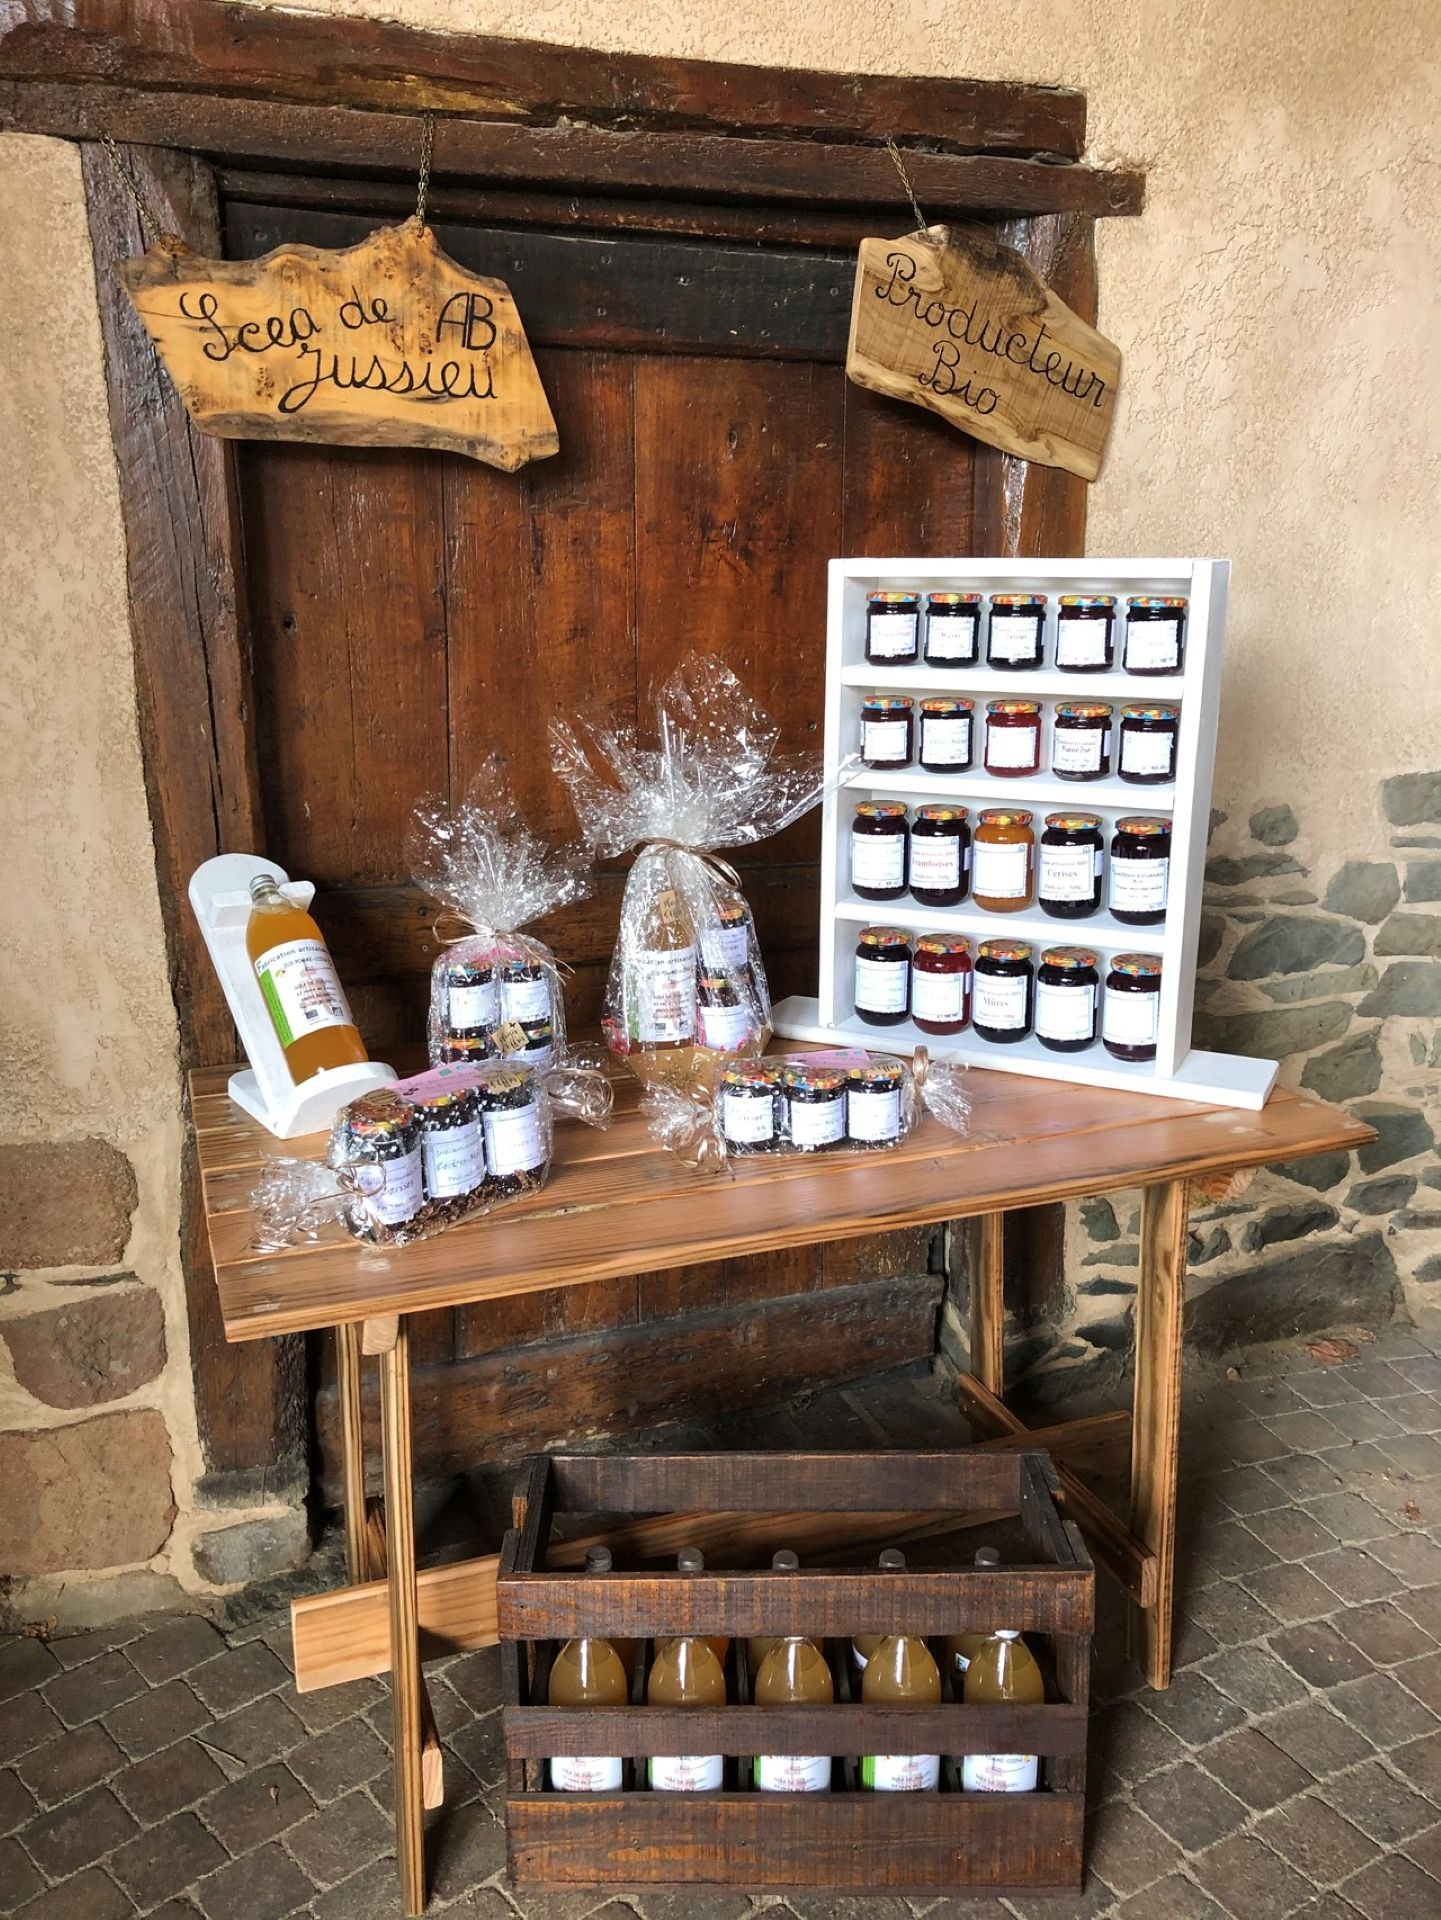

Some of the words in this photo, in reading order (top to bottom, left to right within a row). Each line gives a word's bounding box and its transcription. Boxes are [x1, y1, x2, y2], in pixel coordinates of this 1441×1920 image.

[340, 284, 396, 330] de
[436, 291, 498, 351] AB
[875, 252, 1106, 408] Producteur
[278, 341, 498, 413] Jussieu
[917, 340, 1001, 414] Bio
